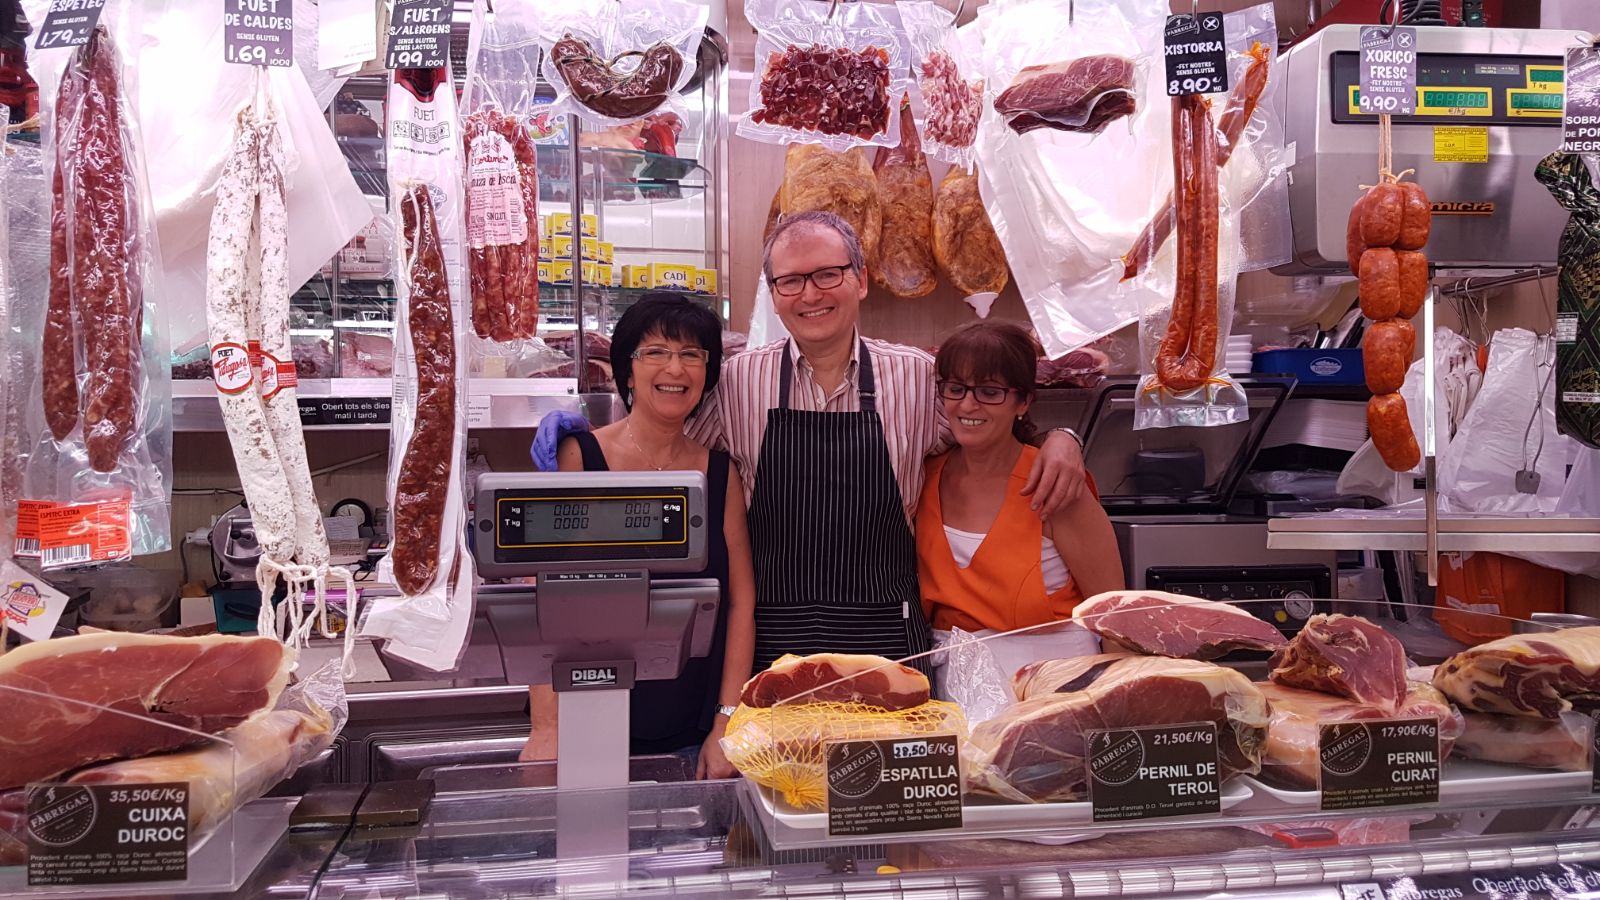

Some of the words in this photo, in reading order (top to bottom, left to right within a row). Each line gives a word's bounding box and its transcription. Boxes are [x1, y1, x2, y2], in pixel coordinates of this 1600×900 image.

[238, 0, 276, 13] FUET
[225, 13, 240, 26] DE
[244, 14, 292, 30] CALDES
[404, 7, 441, 23] FUET
[40, 29, 73, 47] 1,79
[229, 44, 266, 62] 1,69
[1165, 41, 1223, 55] XISTORRA
[390, 52, 422, 68] 1,99
[1366, 50, 1412, 64] XORIÇO
[1370, 66, 1408, 79] FRESC
[1169, 78, 1210, 94] 8,90
[1360, 96, 1398, 112] 9,90
[414, 106, 435, 120] FUET
[664, 271, 686, 280] CADÍ
[572, 668, 616, 680] DIBAL
[1154, 732, 1213, 744] 21,50€/Kg
[1382, 724, 1436, 737] 17,90€/Kg
[1388, 751, 1437, 765] PERNIL
[881, 765, 958, 782] ESPATLLA
[1140, 765, 1192, 780] PERNIL
[1196, 762, 1216, 775] DE
[1392, 768, 1438, 782] CURAT
[109, 788, 186, 804] 35,50€/Kg
[904, 784, 958, 799] DUROC
[1168, 781, 1218, 796] TEROL
[128, 807, 186, 822] CUIXA
[118, 827, 185, 843] DUROC
